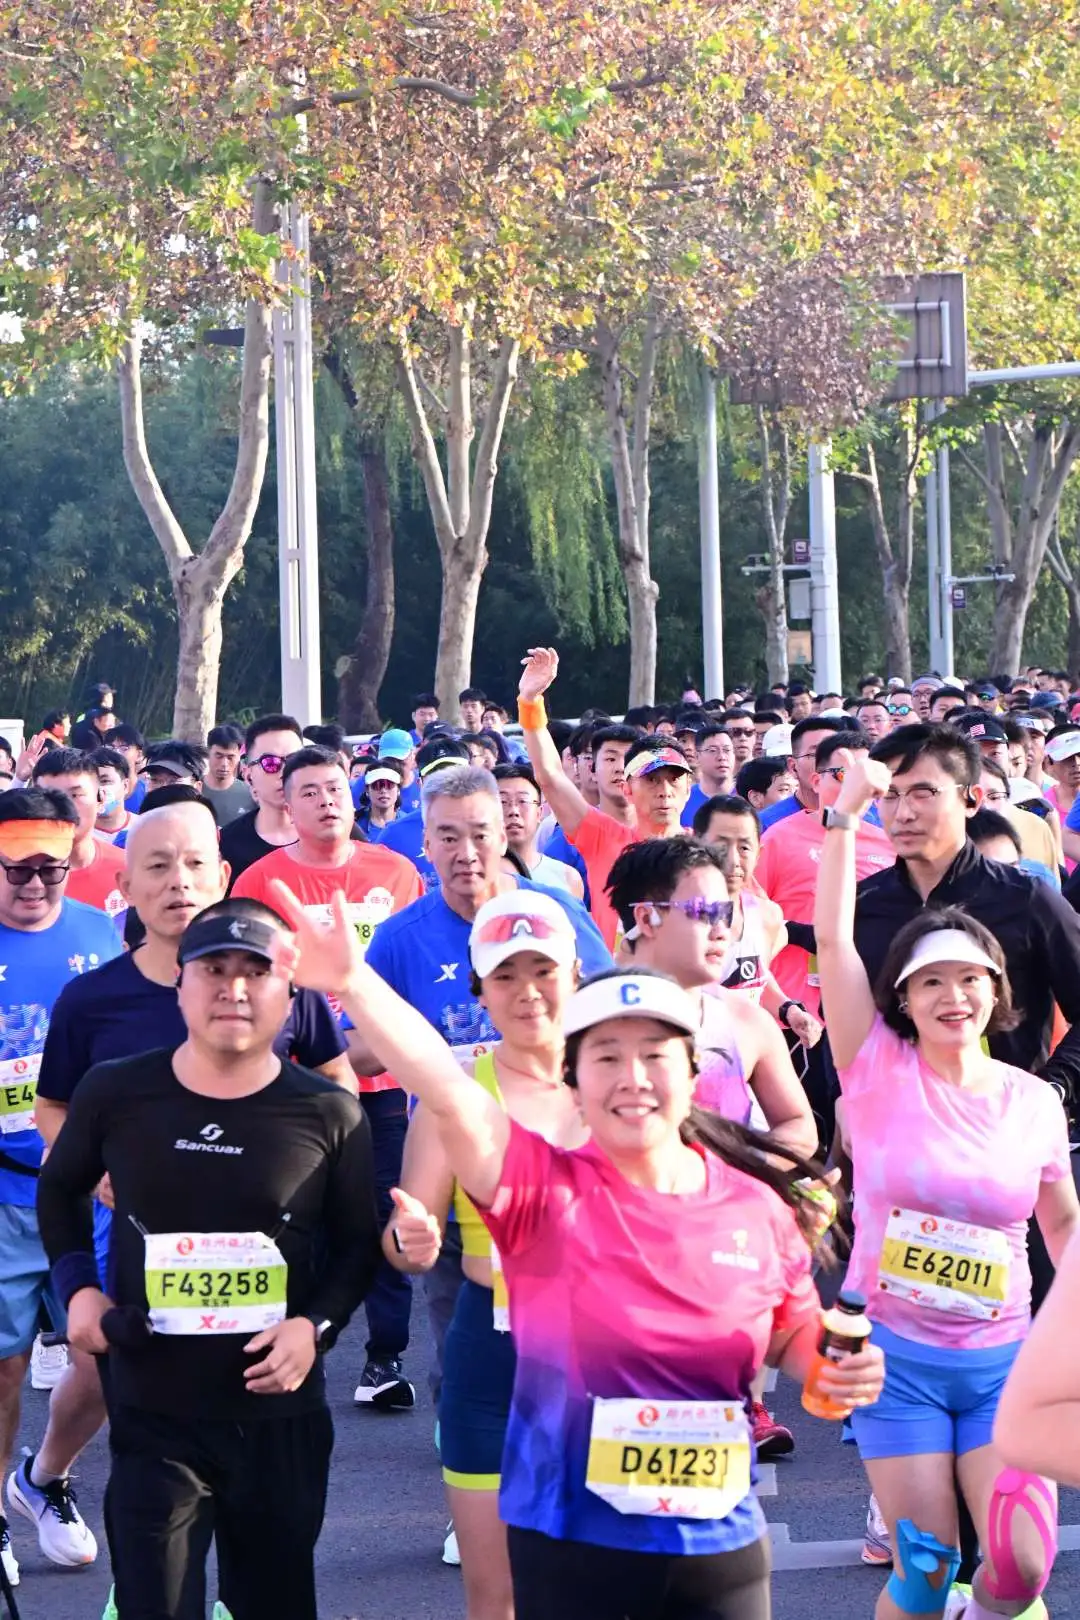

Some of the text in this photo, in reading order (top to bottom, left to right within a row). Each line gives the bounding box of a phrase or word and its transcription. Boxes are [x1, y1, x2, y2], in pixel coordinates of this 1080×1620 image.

[621, 983, 641, 1005] C
[903, 1246, 991, 1287] E62011
[162, 1270, 269, 1297] F43258
[620, 1446, 729, 1476] D61231
